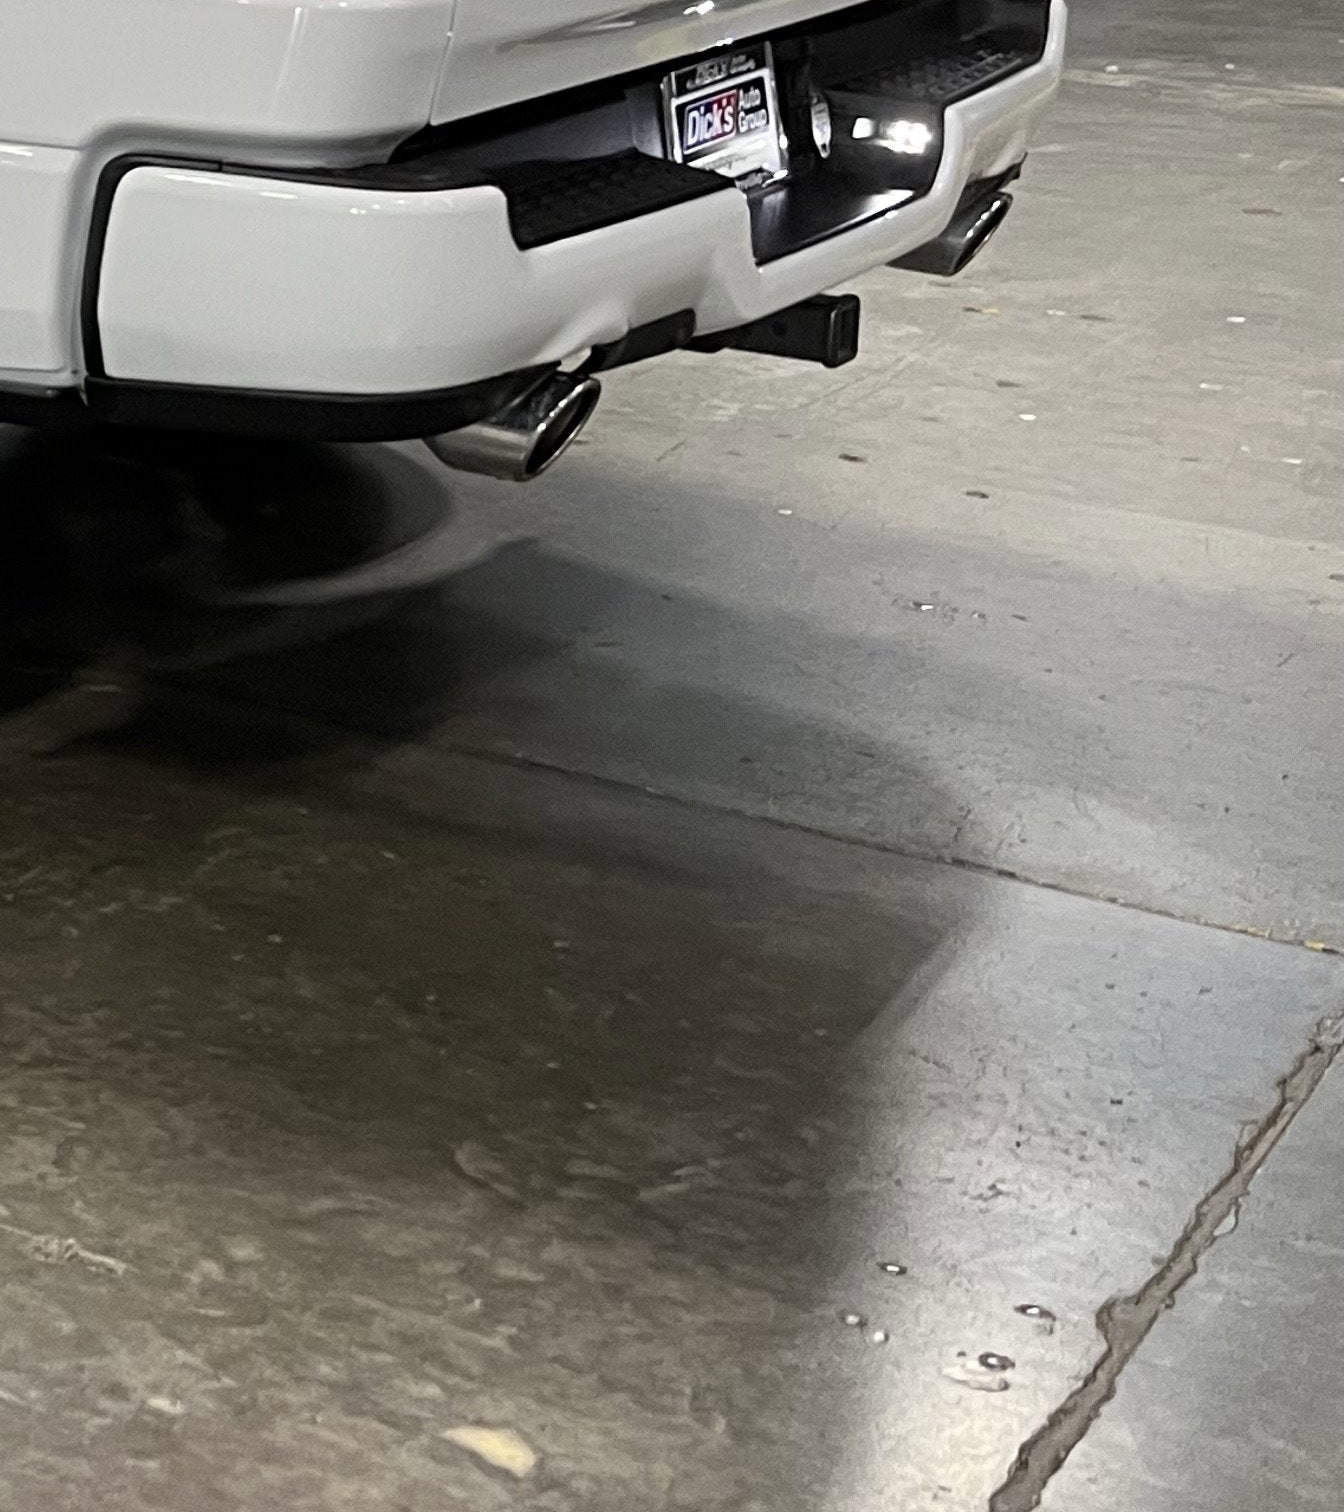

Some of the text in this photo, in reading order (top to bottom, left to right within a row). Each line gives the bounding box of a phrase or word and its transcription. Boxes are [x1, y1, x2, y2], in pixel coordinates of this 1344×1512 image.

[687, 86, 761, 147] Dick's Auto
[738, 108, 768, 134] Group
